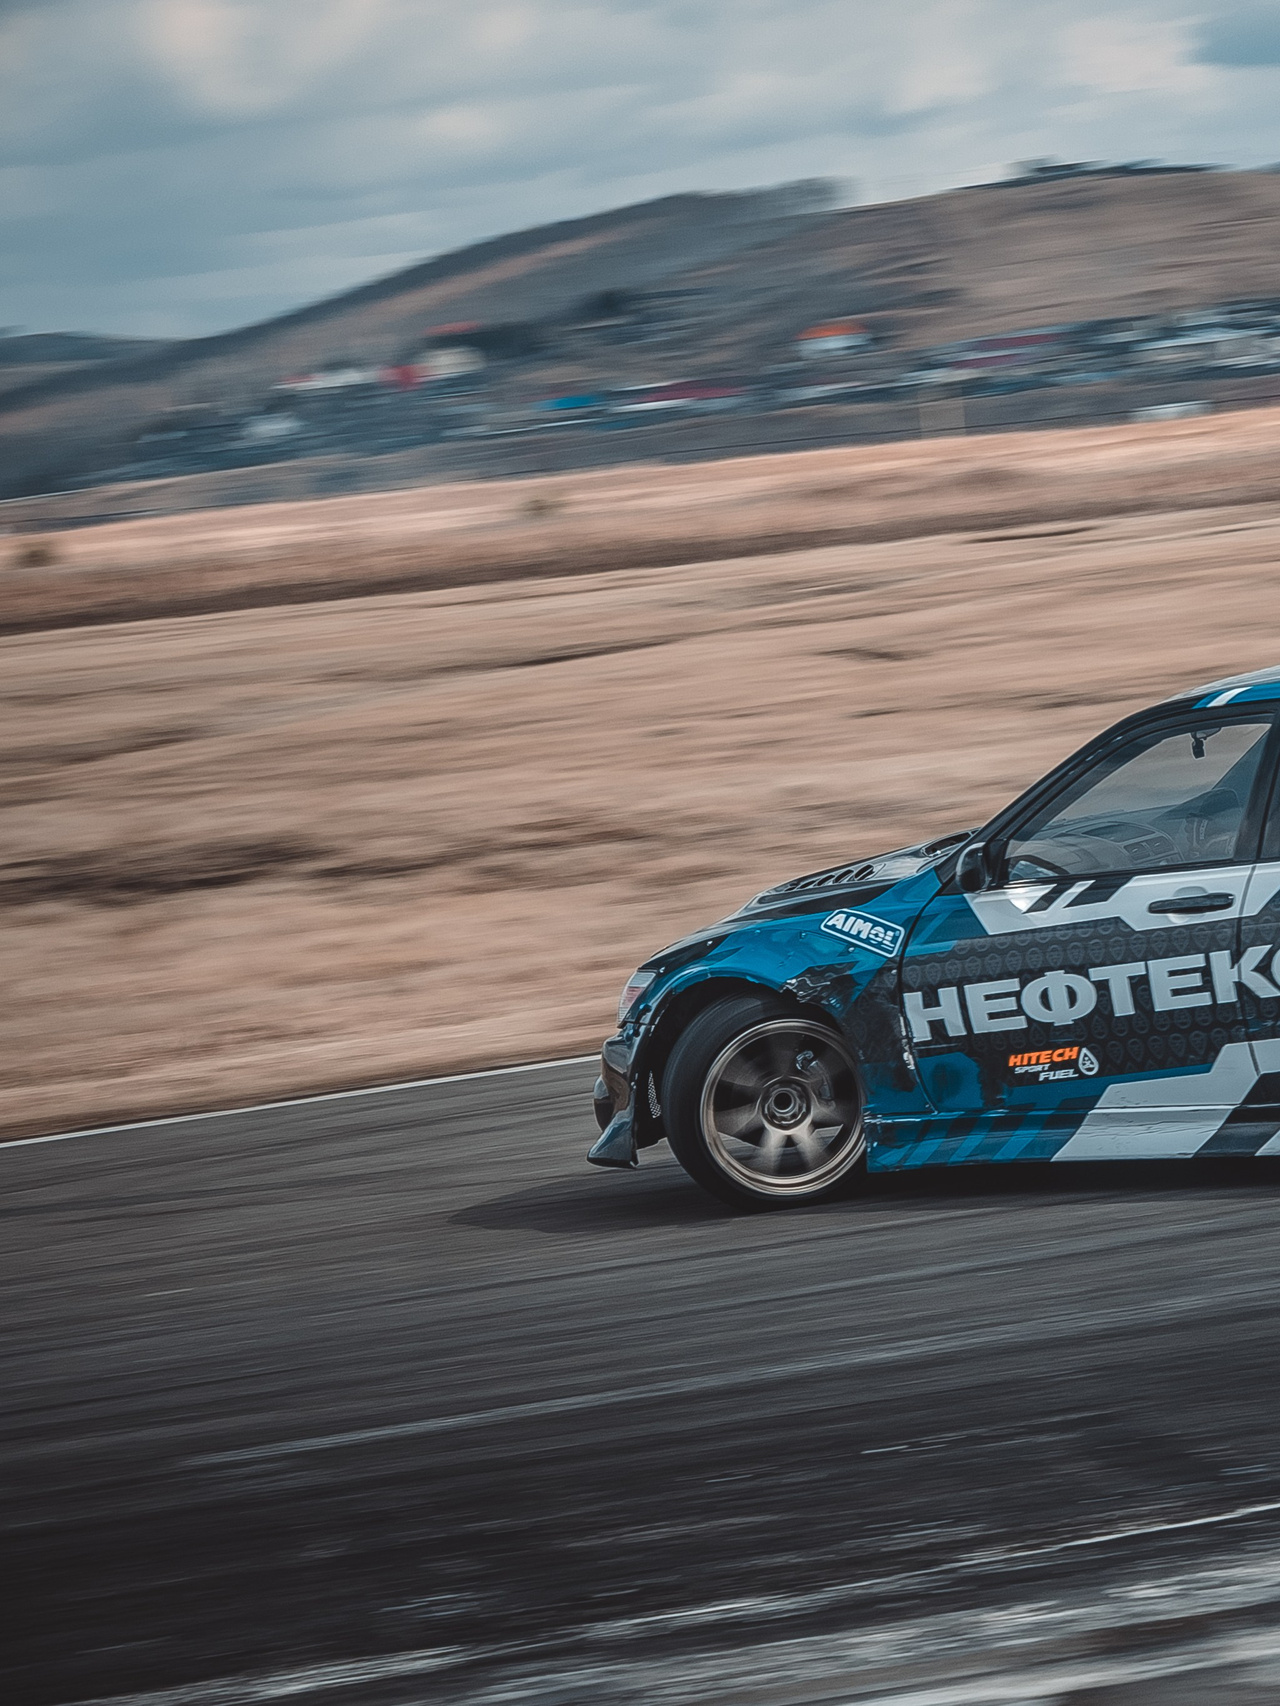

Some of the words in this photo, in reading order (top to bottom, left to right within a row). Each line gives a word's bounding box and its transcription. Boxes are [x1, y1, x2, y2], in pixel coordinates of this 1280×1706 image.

[826, 913, 895, 951] AIMOL
[1008, 1046, 1080, 1067] HITECH
[1014, 1063, 1052, 1074] SPORT
[1038, 1068, 1079, 1081] FUEL
